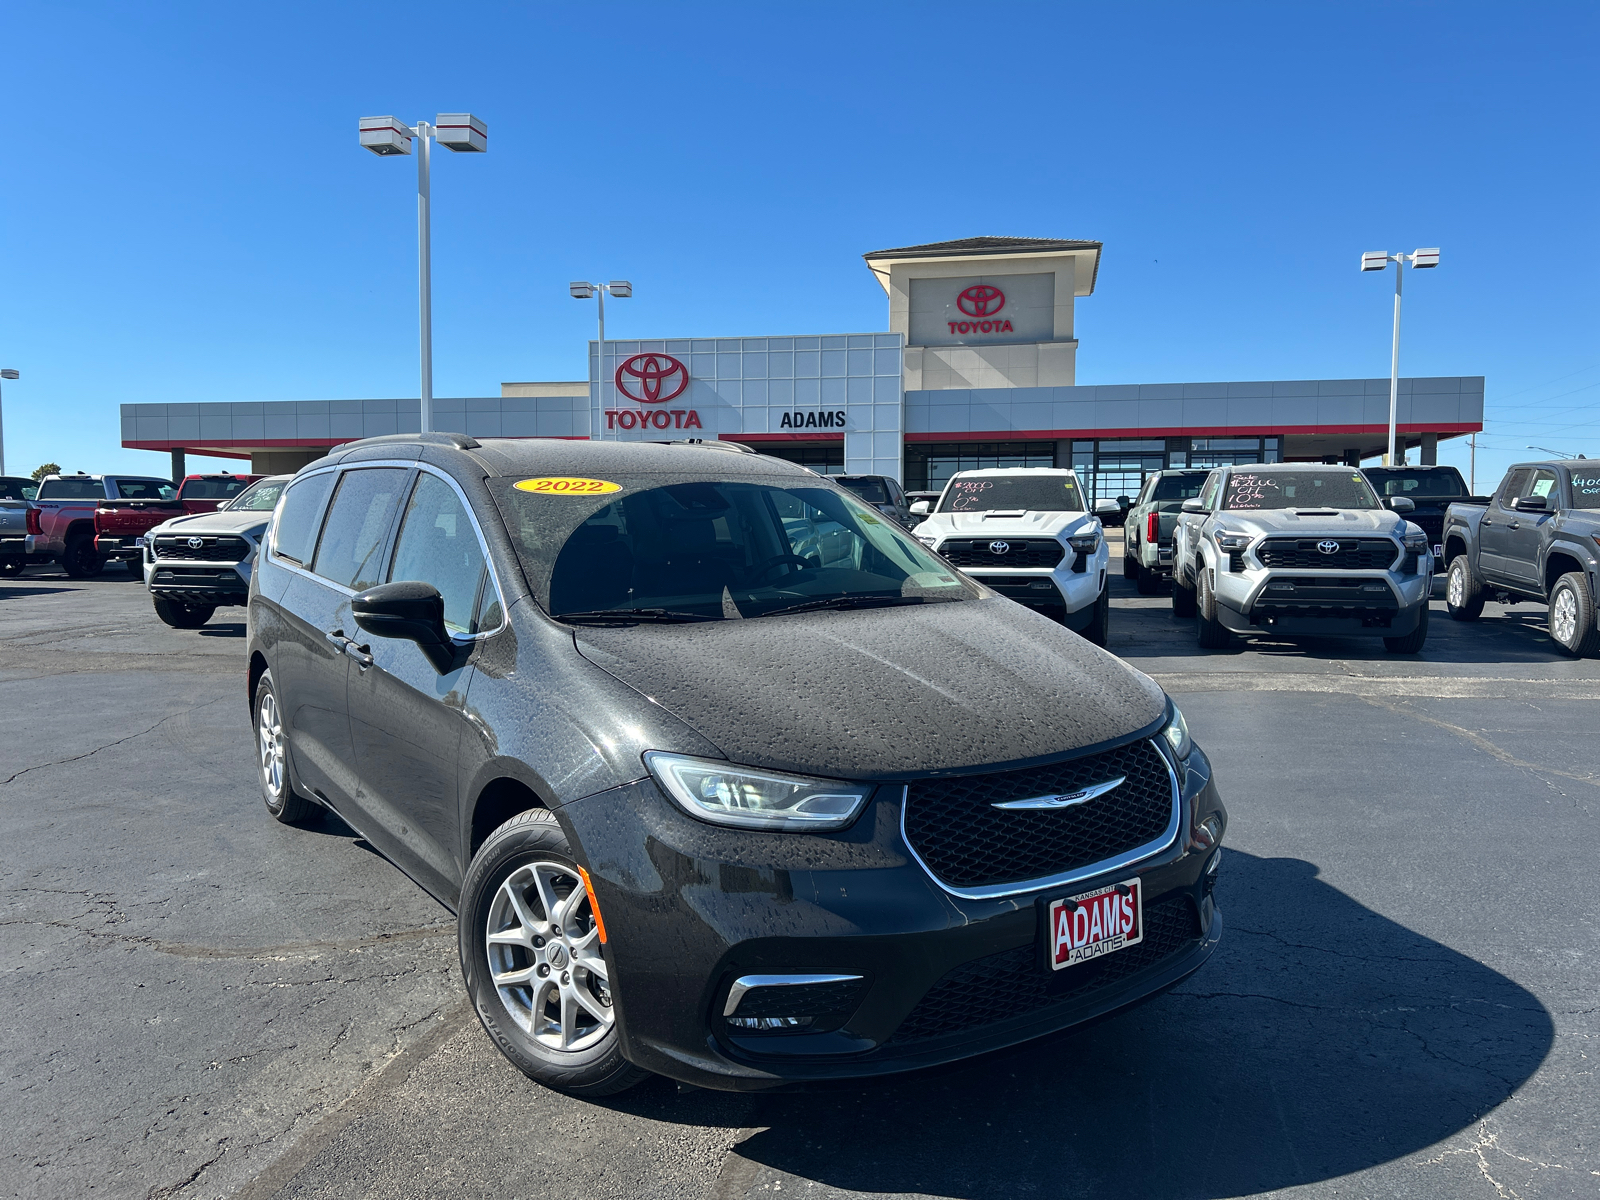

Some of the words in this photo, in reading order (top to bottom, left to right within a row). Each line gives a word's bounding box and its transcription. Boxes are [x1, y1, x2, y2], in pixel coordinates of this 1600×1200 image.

[947, 319, 1014, 335] TOYOTA
[604, 409, 703, 430] TOYOTA
[780, 411, 846, 428] ADAMS
[534, 480, 604, 492] 2022
[1075, 886, 1103, 902] KANSAS
[1104, 884, 1118, 894] CIT
[1055, 892, 1134, 956] ADAMS
[1074, 935, 1123, 963] ADAMS
